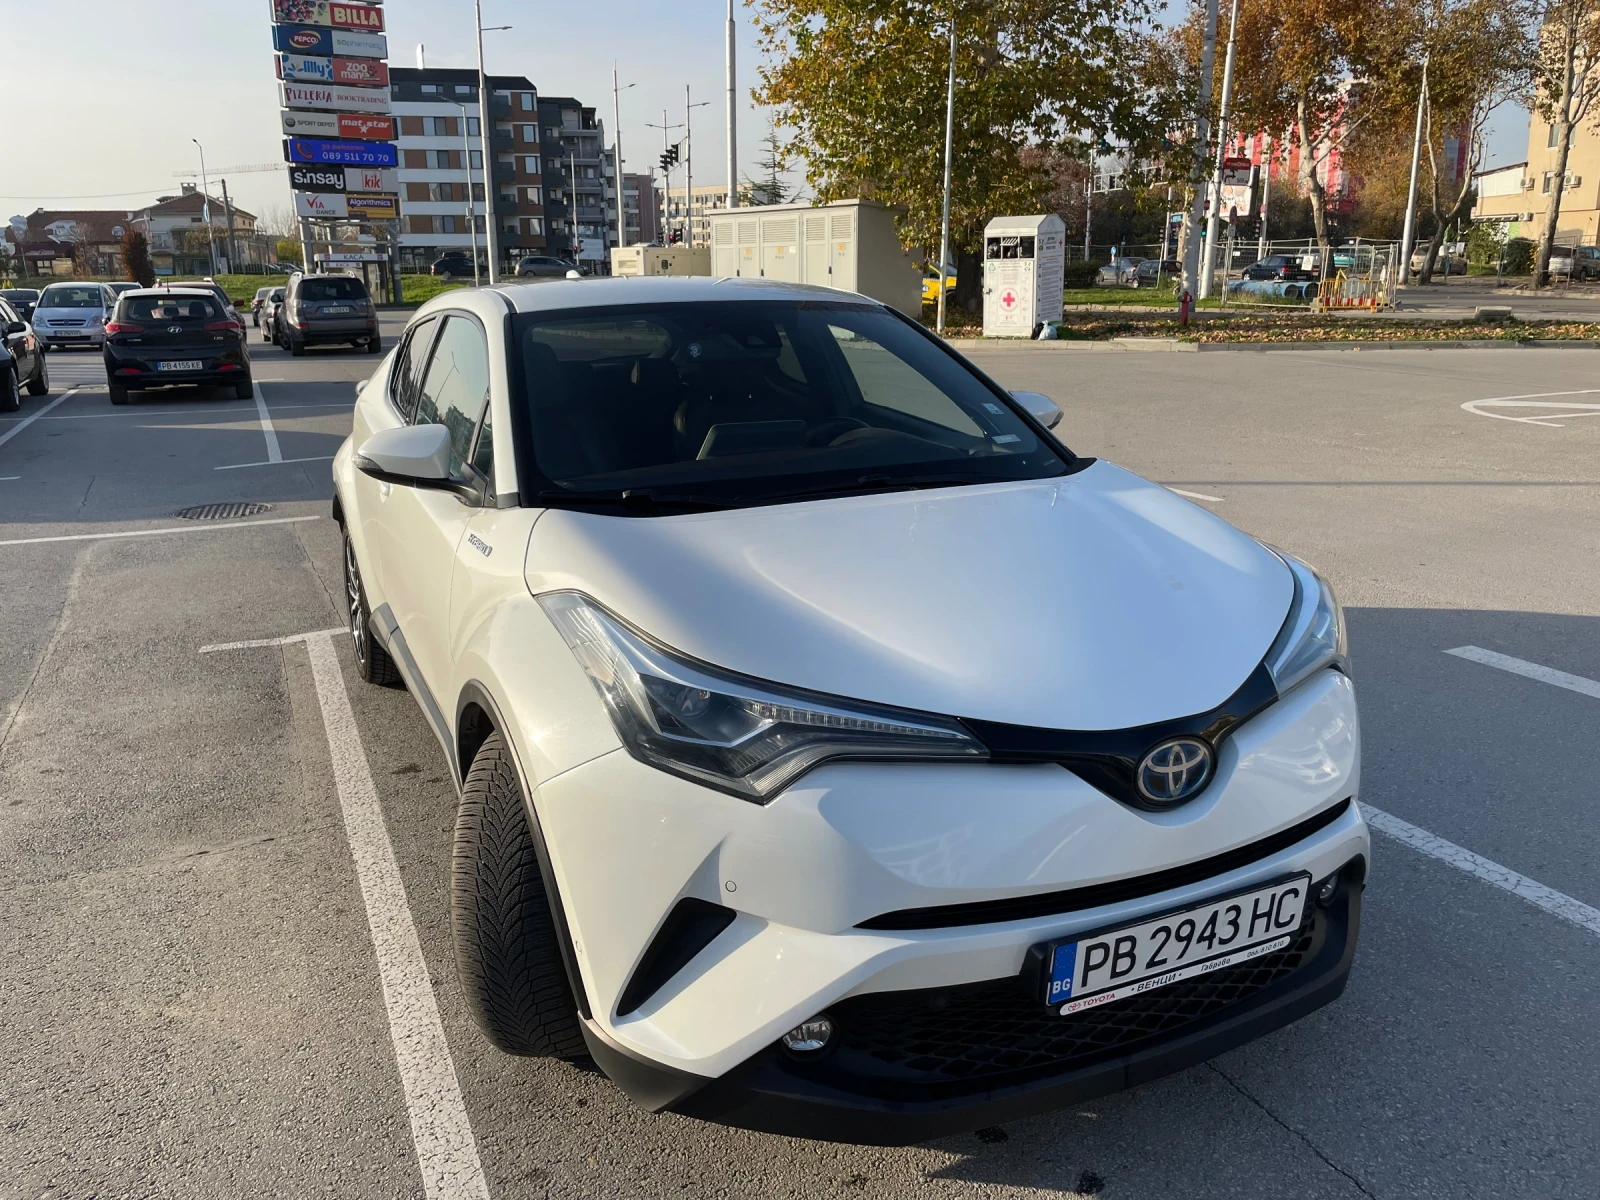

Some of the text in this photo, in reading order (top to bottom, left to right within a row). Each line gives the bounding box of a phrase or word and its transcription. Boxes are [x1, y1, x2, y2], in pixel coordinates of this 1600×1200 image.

[333, 7, 380, 26] BILLA
[293, 35, 317, 44] PEPCO
[303, 60, 325, 77] lilly
[285, 87, 332, 103] PIZZERIA
[337, 94, 387, 105] BOOKTRADING
[297, 119, 336, 128] SPORT DEPOT
[341, 119, 390, 129] mat star
[322, 152, 389, 163] 089 511 70 70
[294, 169, 344, 189] sinsay
[349, 198, 391, 207] Algorithmics
[191, 361, 201, 369] KE
[1081, 887, 1300, 988] PB 2943 HC
[1052, 979, 1071, 994] BG
[1082, 992, 1116, 1007] TOYOTA
